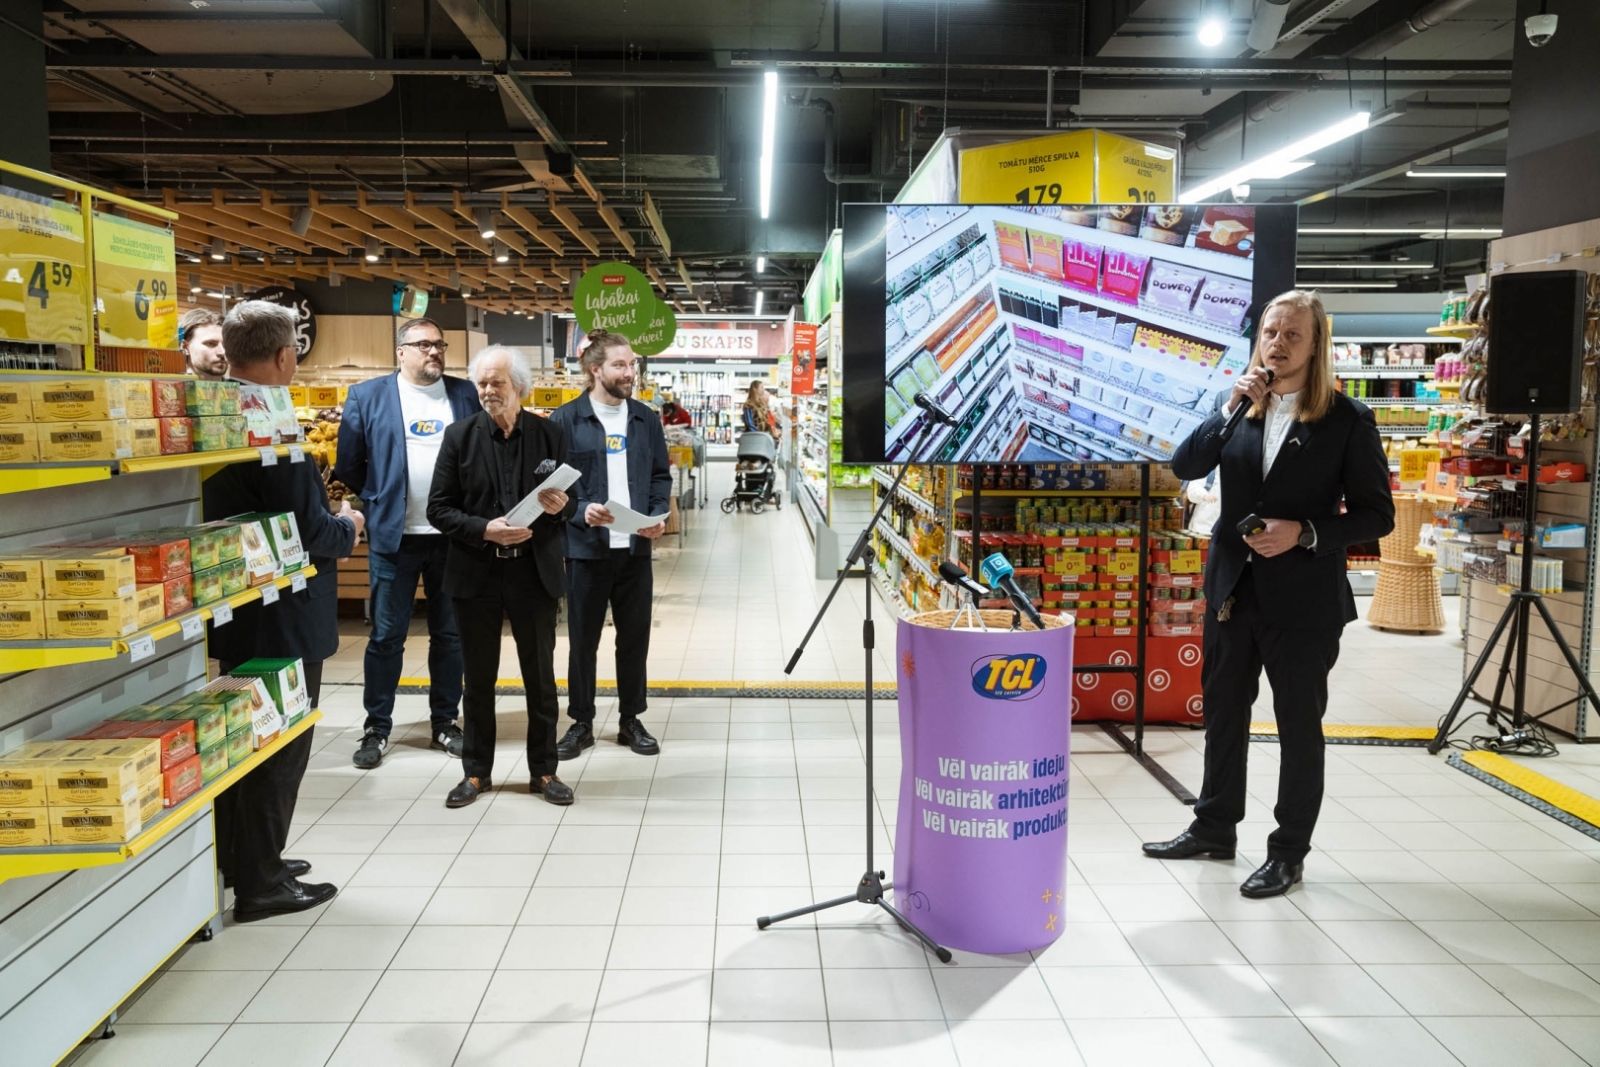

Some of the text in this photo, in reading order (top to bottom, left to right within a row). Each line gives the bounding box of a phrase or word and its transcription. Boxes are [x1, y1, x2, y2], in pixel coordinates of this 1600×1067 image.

[998, 150, 1080, 169] TOMĀTU MĒRCE SPILVA
[1028, 165, 1045, 174] 510G
[28, 261, 72, 310] 4 59
[1152, 279, 1192, 294] POWER
[134, 278, 168, 321] 6 99
[585, 287, 640, 310] Labākai
[1203, 292, 1247, 308] POWER
[592, 308, 637, 329] dzīvei!
[691, 335, 754, 350] SKAPIS
[50, 391, 88, 402] TWININGS
[57, 431, 95, 442] TWININGS
[416, 421, 437, 434] TCL
[282, 540, 301, 559] merci
[62, 570, 99, 579] TWININGS
[64, 610, 101, 620] TWININGS
[985, 658, 1036, 691] TCL
[286, 687, 306, 711] merci
[254, 706, 277, 731] merci
[938, 754, 1065, 781] Vēl vairāk ideju
[65, 778, 101, 788] TWININGS
[915, 776, 933, 802] Vēl
[935, 787, 995, 810] vairāk
[69, 816, 106, 826] TWININGS
[922, 808, 946, 834] Vēl
[949, 818, 1009, 839] vairāk
